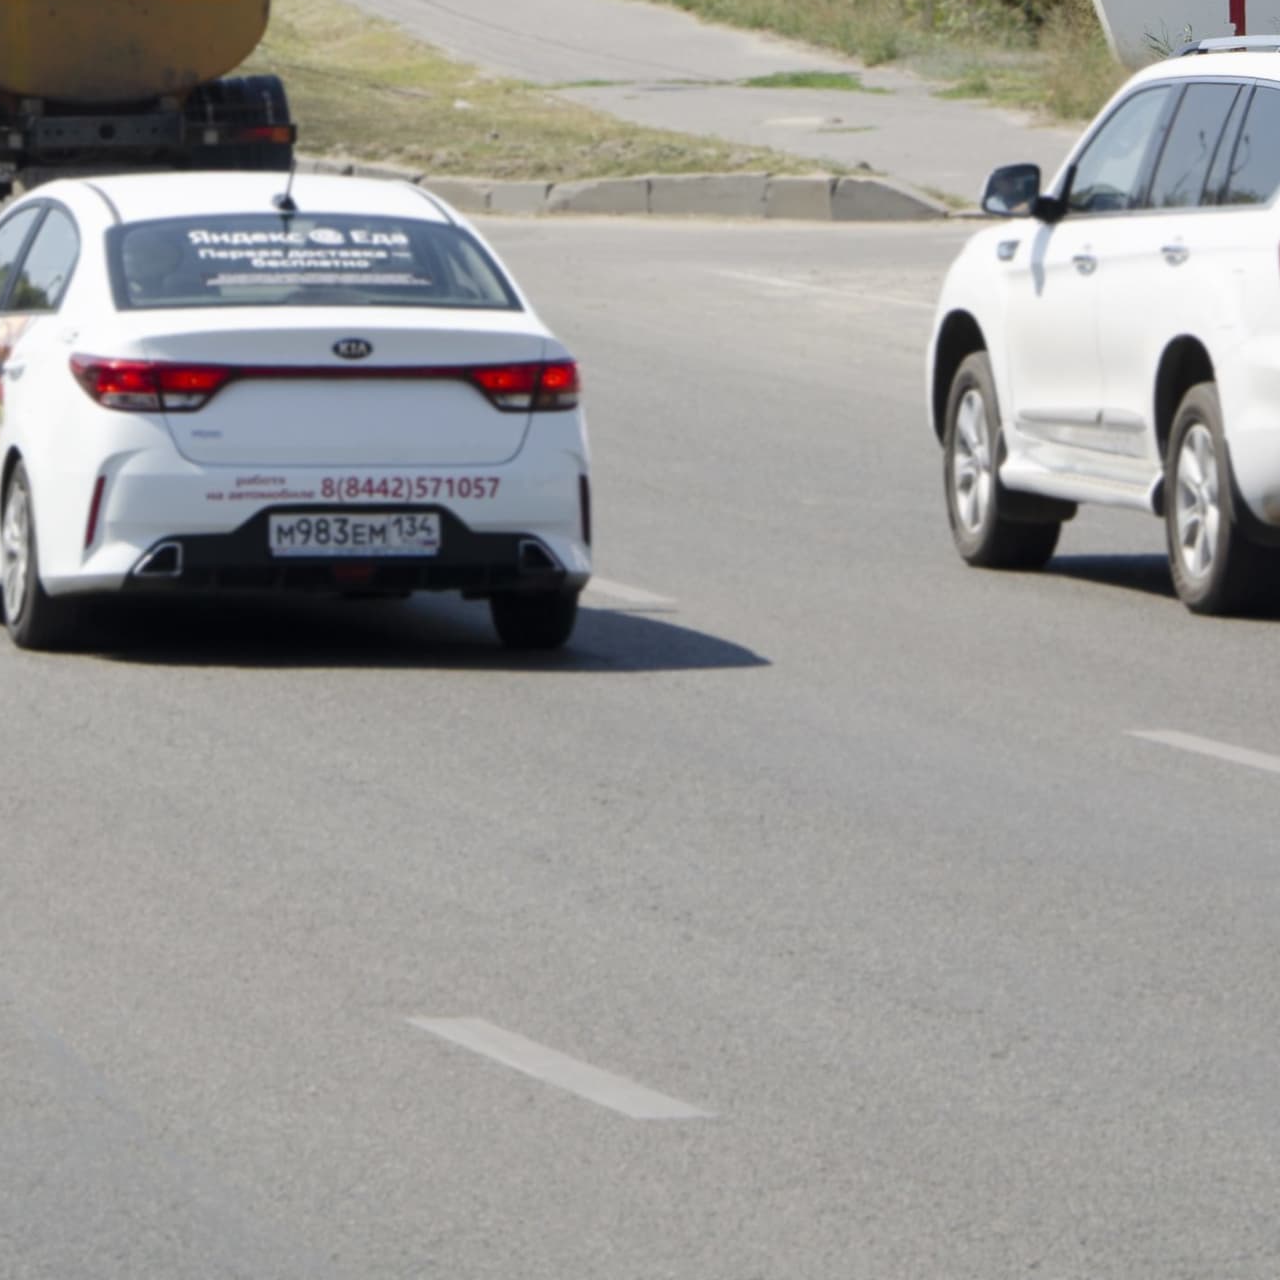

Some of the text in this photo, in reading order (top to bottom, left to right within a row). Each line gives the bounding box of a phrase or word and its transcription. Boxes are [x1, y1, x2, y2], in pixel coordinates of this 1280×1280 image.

[187, 228, 409, 247] Яндекс Еда
[321, 476, 502, 502] 8(8442)571057
[276, 516, 434, 546] М983ЕМ 134
